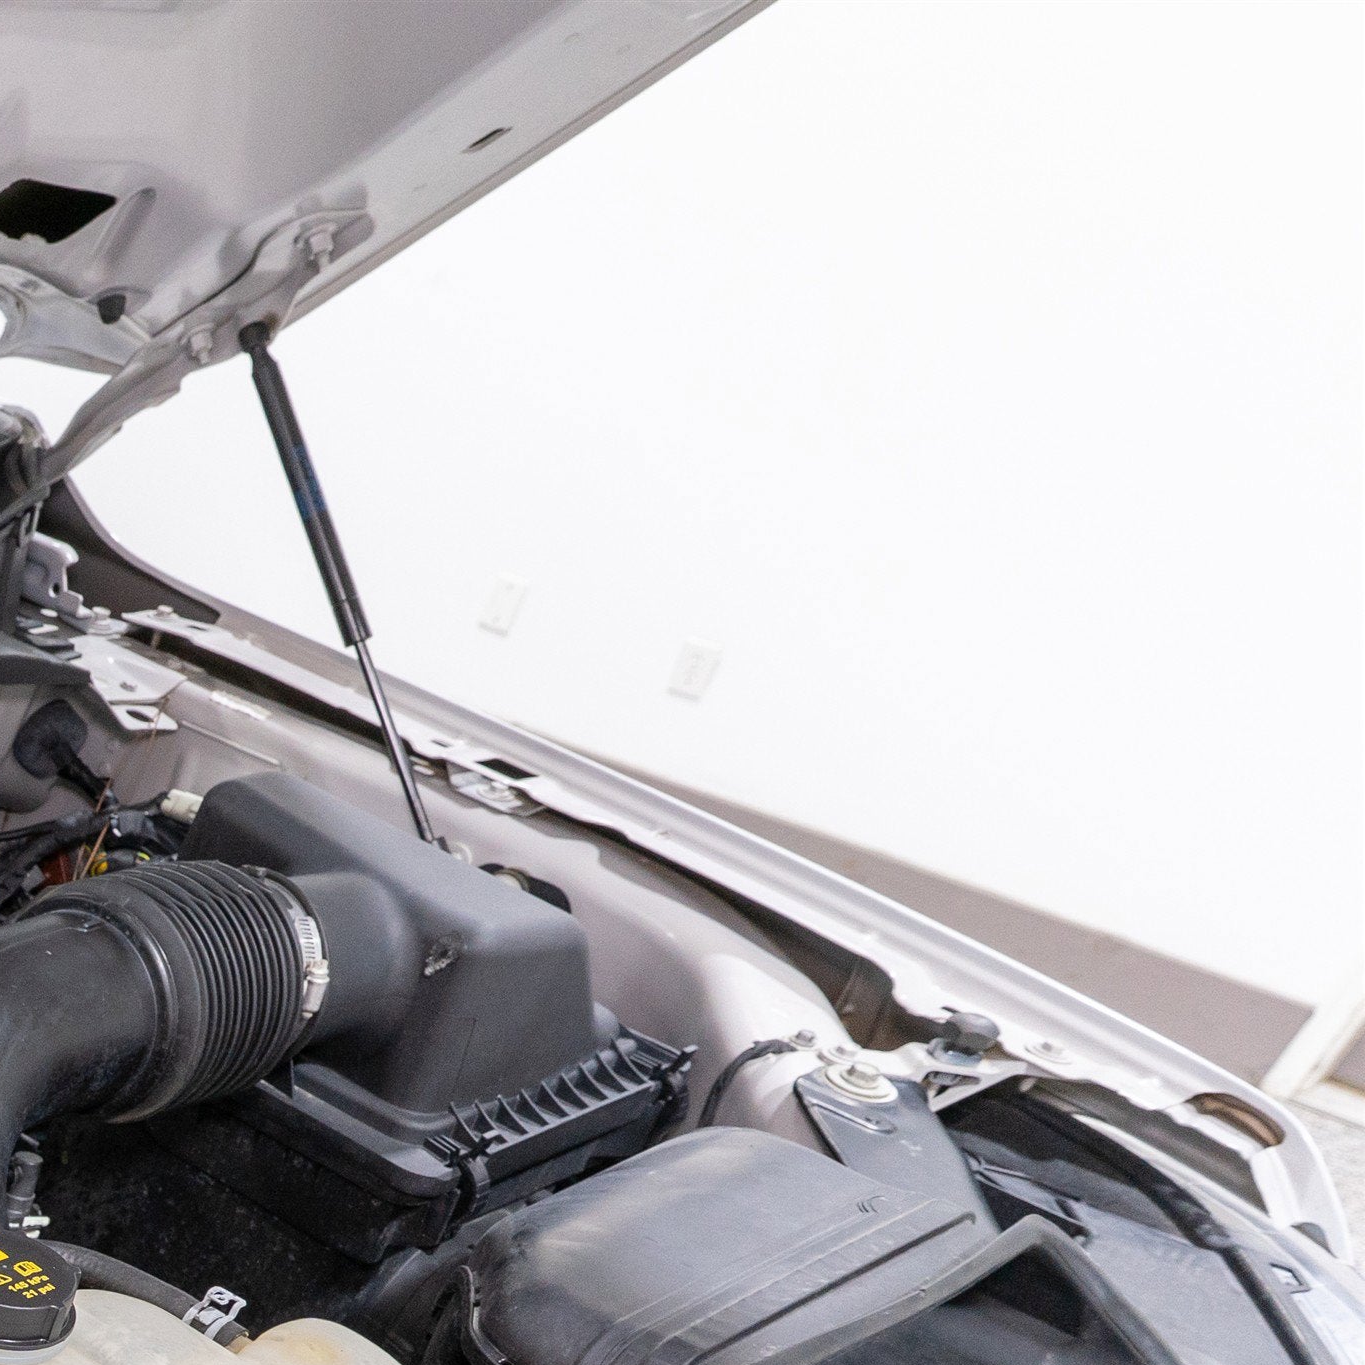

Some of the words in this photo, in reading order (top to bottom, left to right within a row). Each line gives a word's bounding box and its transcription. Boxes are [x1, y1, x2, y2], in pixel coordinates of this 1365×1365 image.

[8, 1281, 29, 1292] 145
[26, 1275, 50, 1286] kPa
[22, 1289, 38, 1299] 21
[37, 1283, 56, 1295] psi
